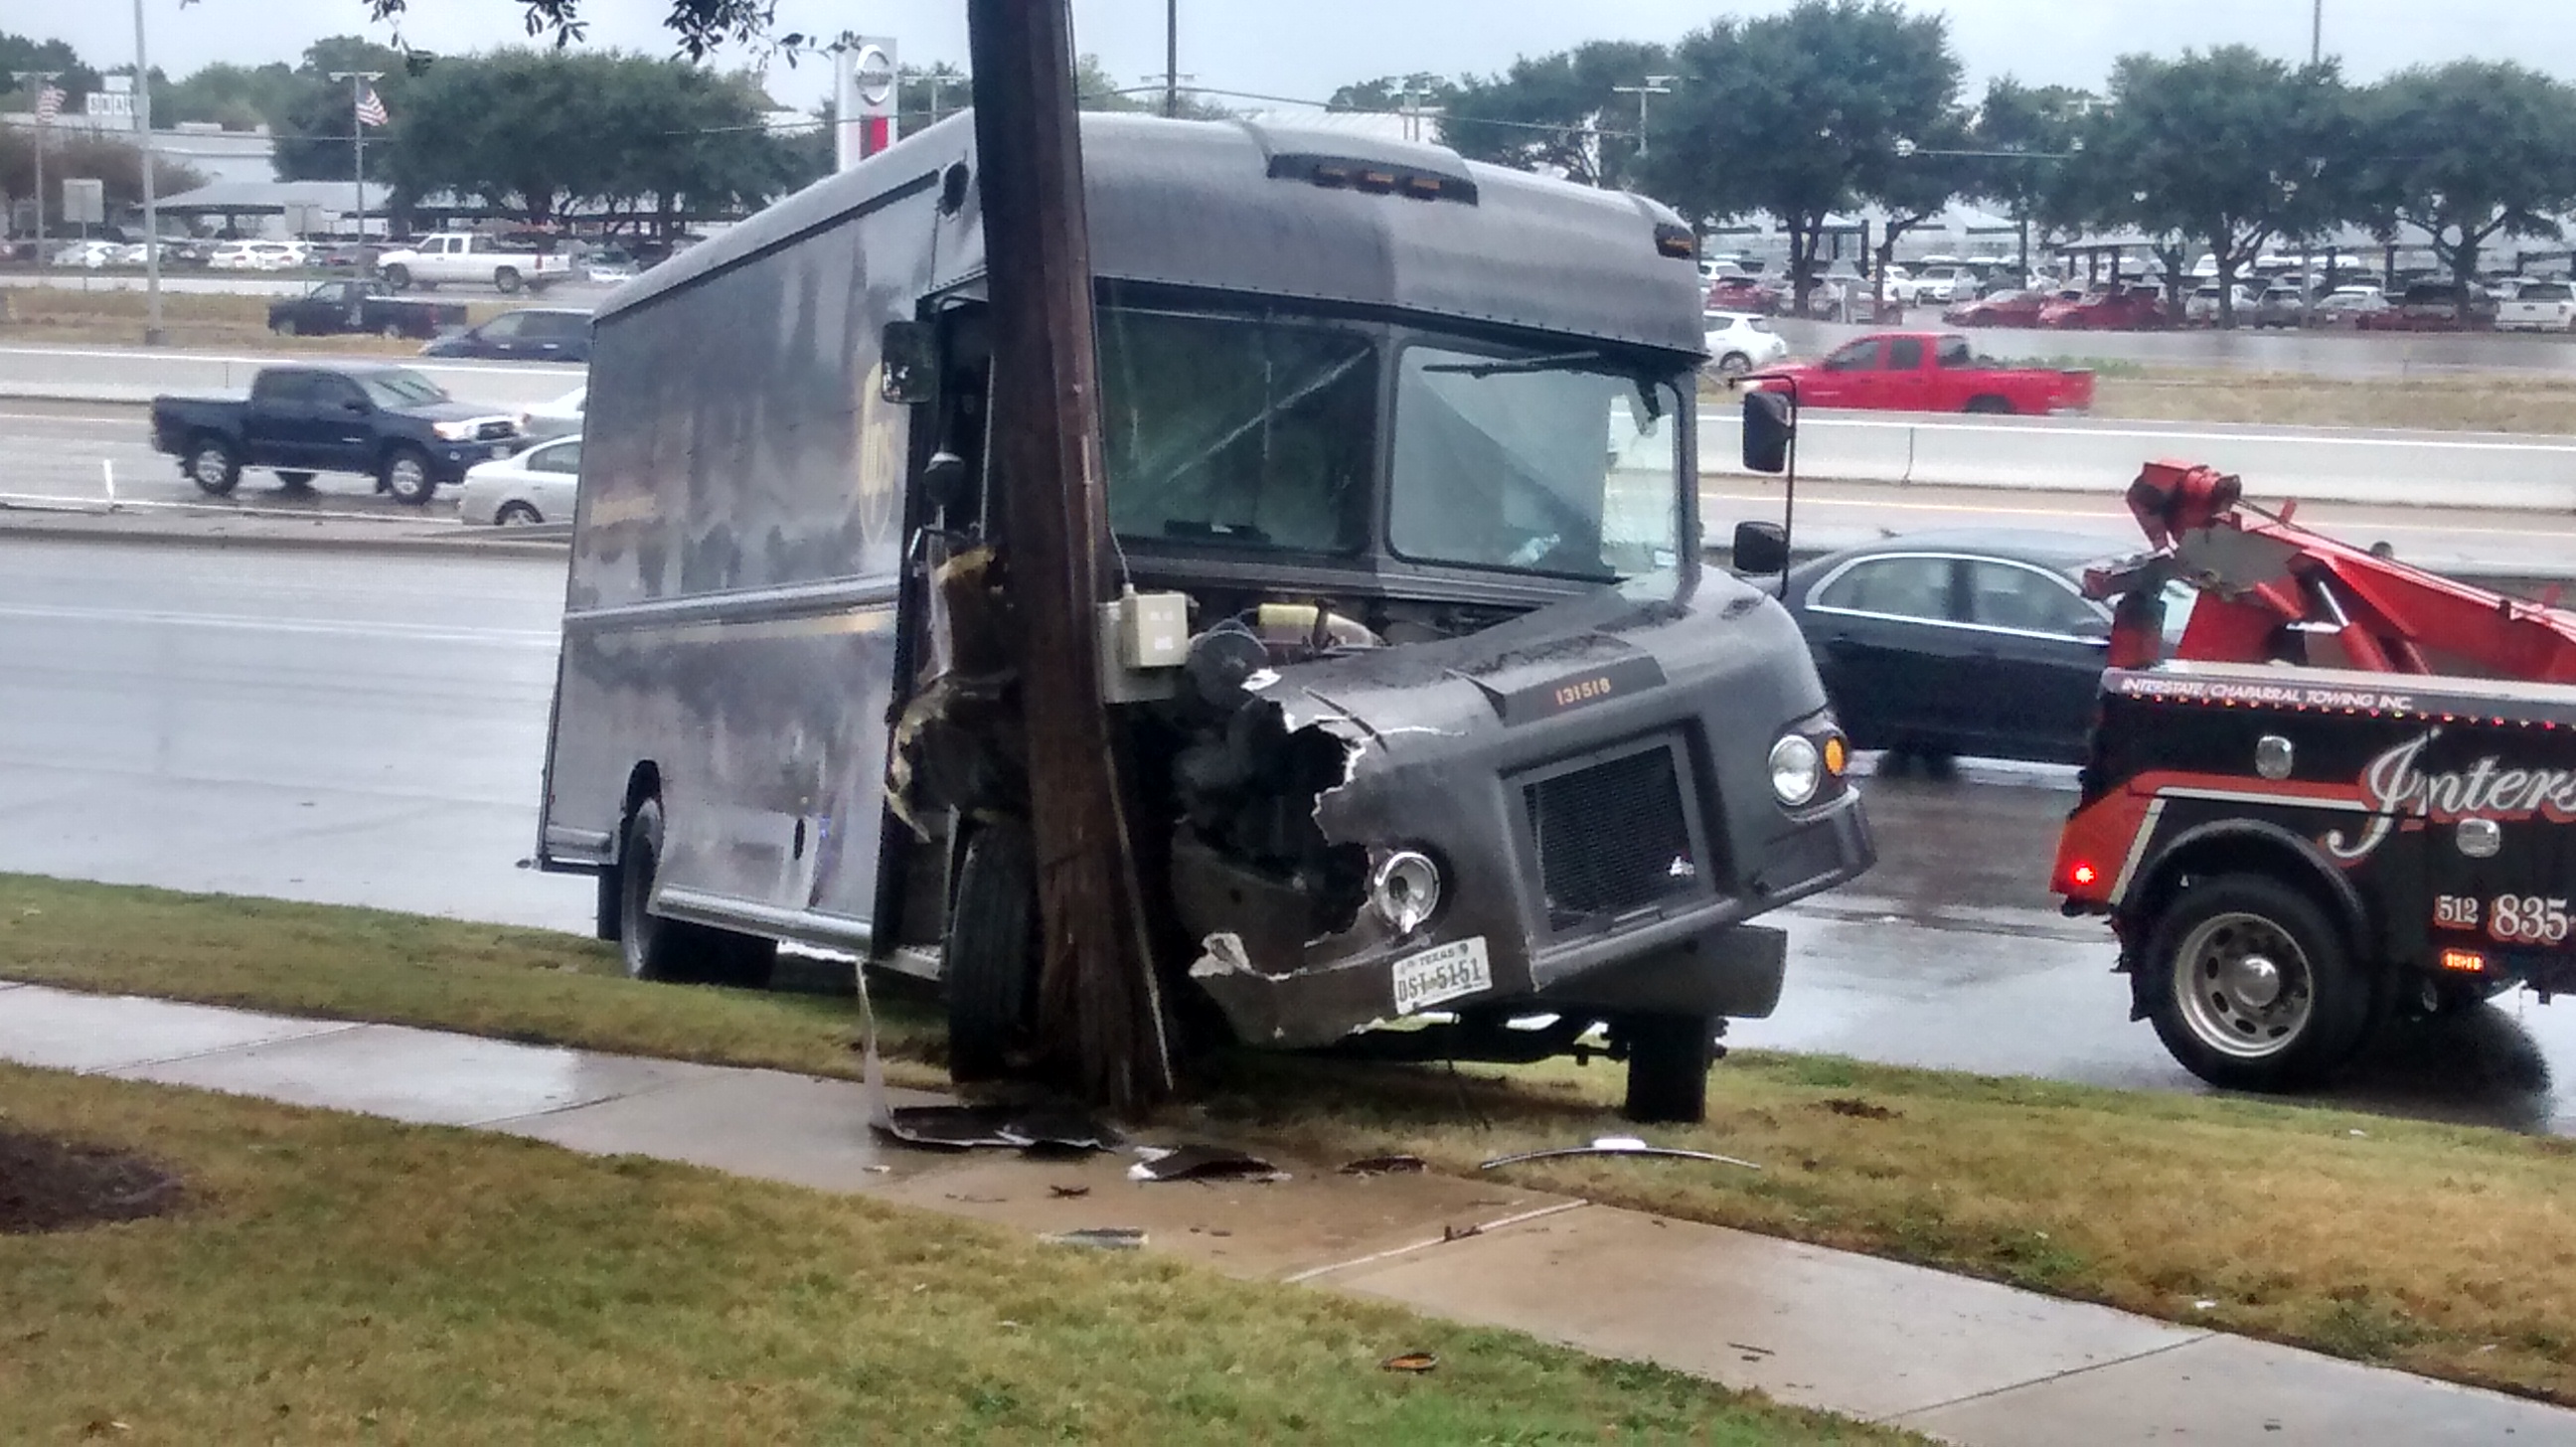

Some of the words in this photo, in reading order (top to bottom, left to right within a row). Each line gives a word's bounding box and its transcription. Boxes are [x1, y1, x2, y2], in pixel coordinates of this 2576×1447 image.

[1555, 677, 1611, 706] 131518
[2305, 690, 2375, 709] TOWING
[2438, 894, 2480, 924] 512
[1419, 948, 1455, 966] TEXAS
